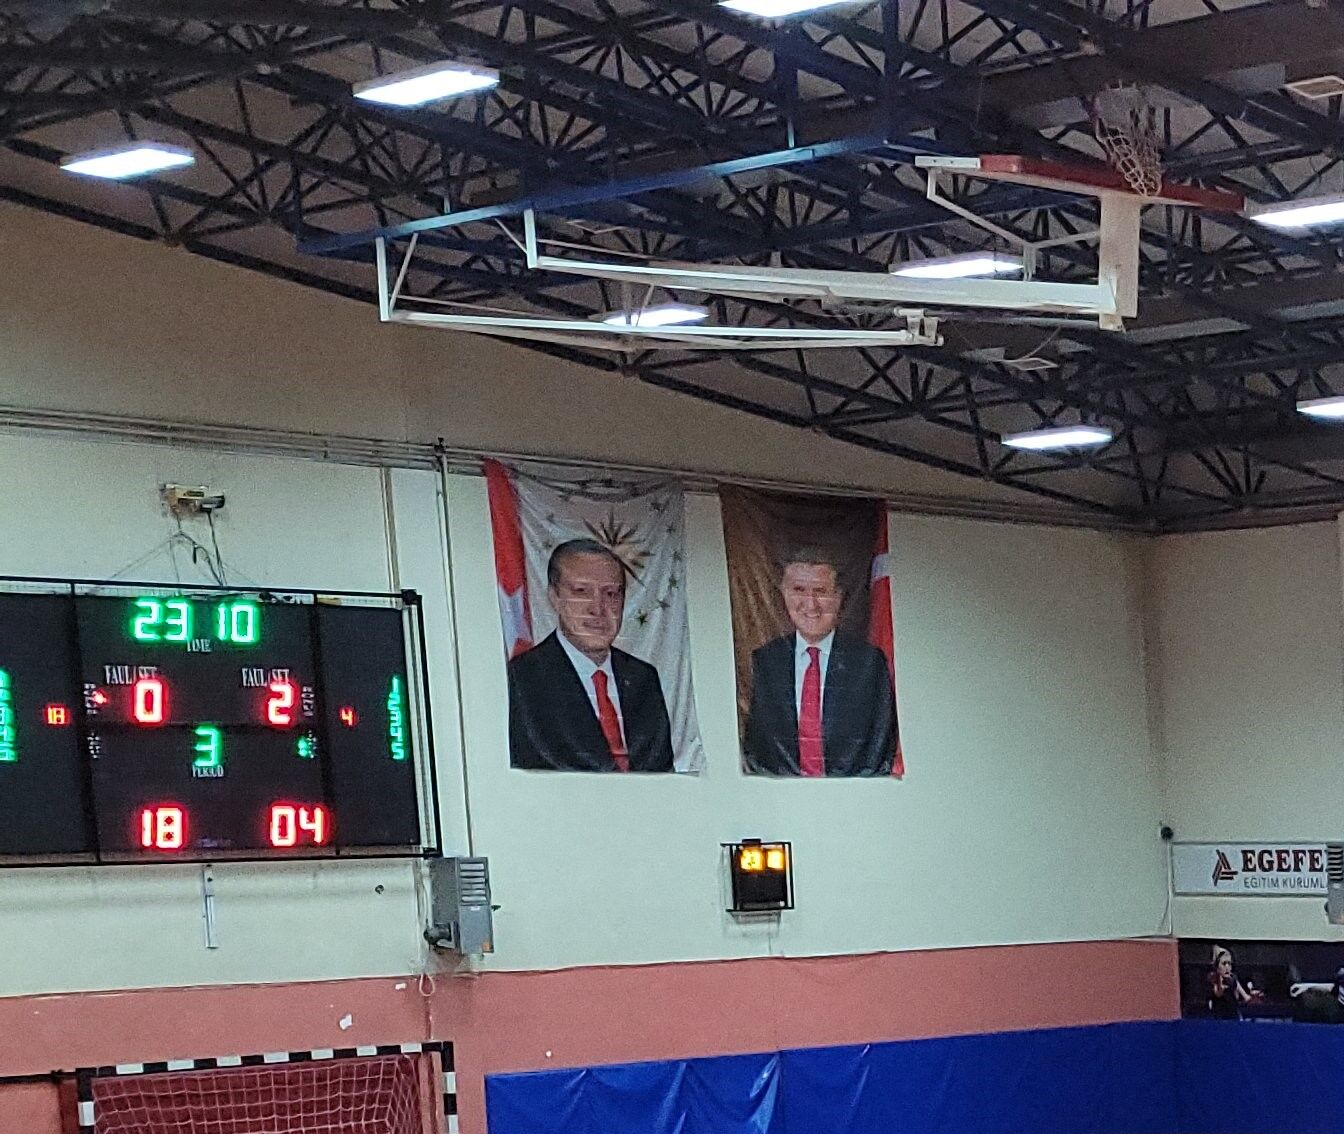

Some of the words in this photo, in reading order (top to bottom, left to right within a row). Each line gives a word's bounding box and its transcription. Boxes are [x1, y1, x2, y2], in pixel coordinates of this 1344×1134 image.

[133, 600, 190, 641] 23
[216, 602, 256, 643] 10
[134, 679, 164, 723] 0
[268, 683, 294, 725] 2
[195, 727, 218, 768] 3
[141, 806, 183, 849] 18
[270, 805, 325, 848] 04
[1241, 849, 1328, 873] EGEFE
[1282, 876, 1326, 889] KURUML
